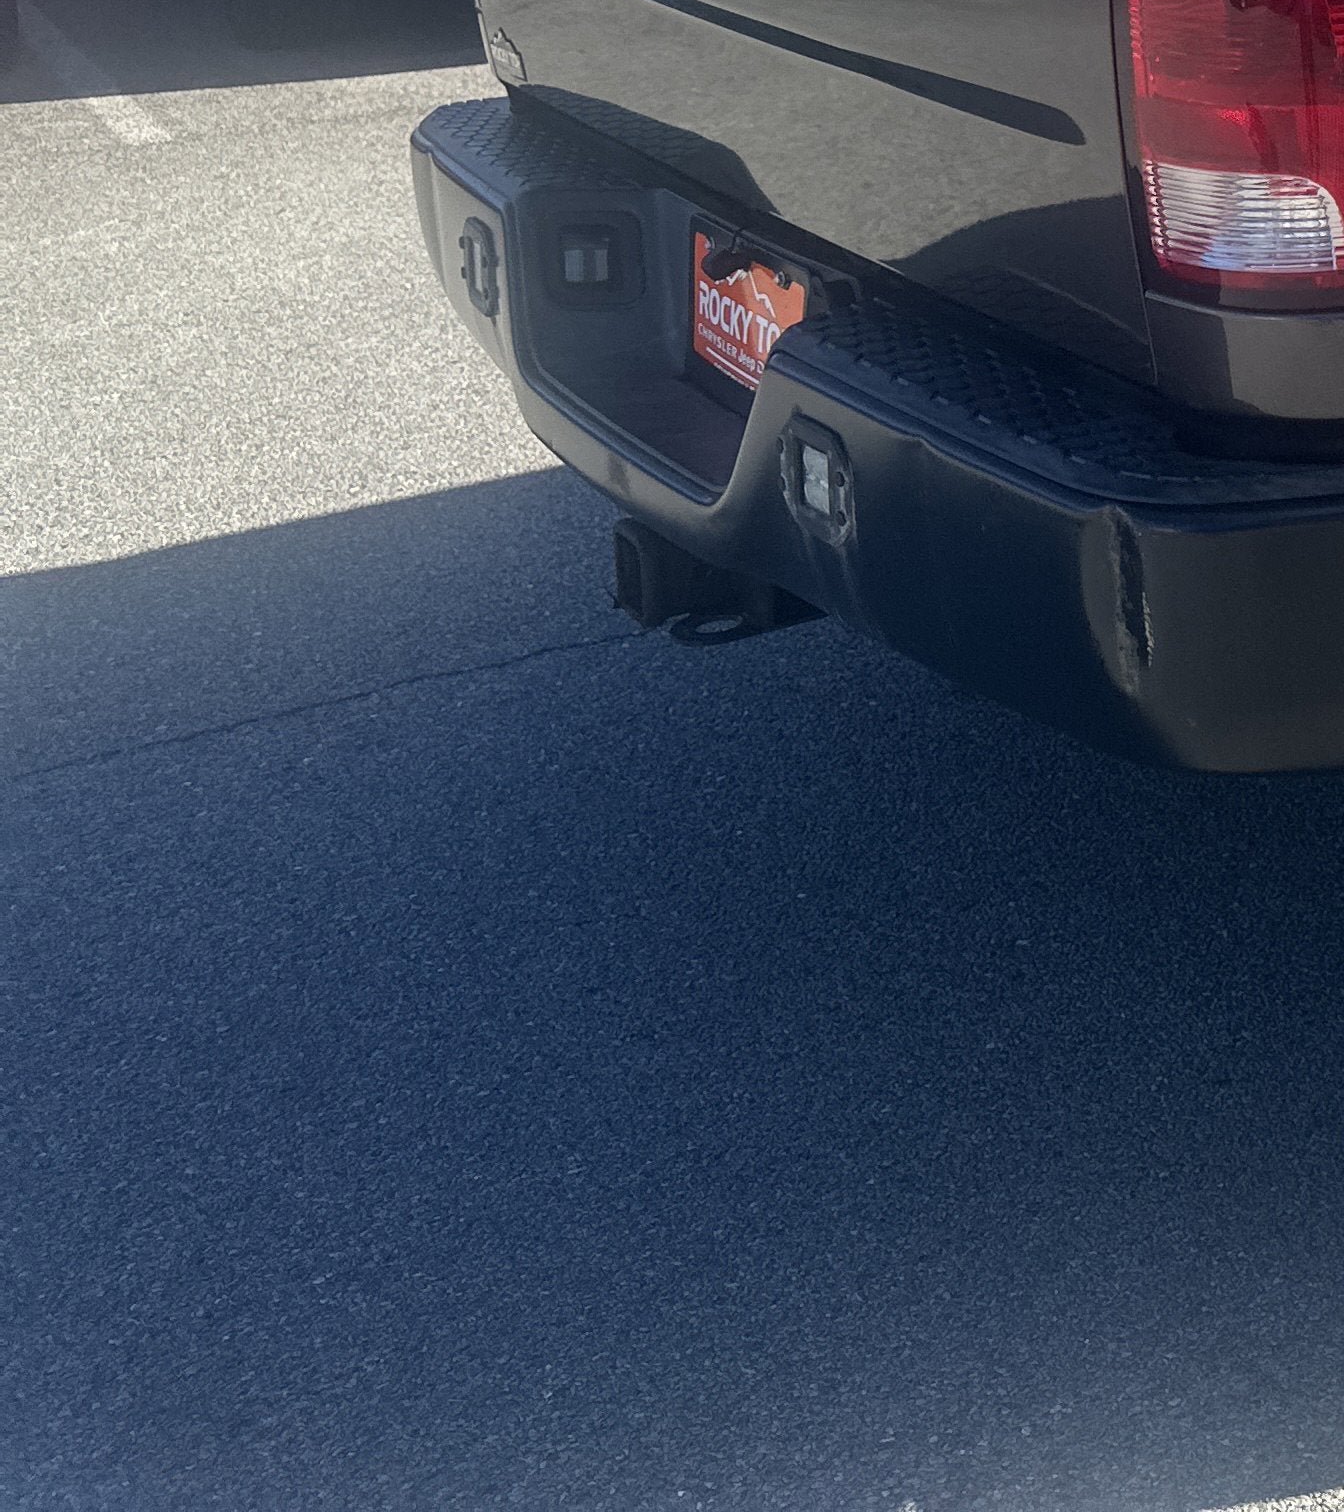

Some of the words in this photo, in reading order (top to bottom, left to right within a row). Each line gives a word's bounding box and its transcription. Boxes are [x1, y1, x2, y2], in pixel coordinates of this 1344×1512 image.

[698, 323, 737, 359] CHRYSLER
[699, 281, 753, 345] ROCKY
[755, 314, 786, 353] TO
